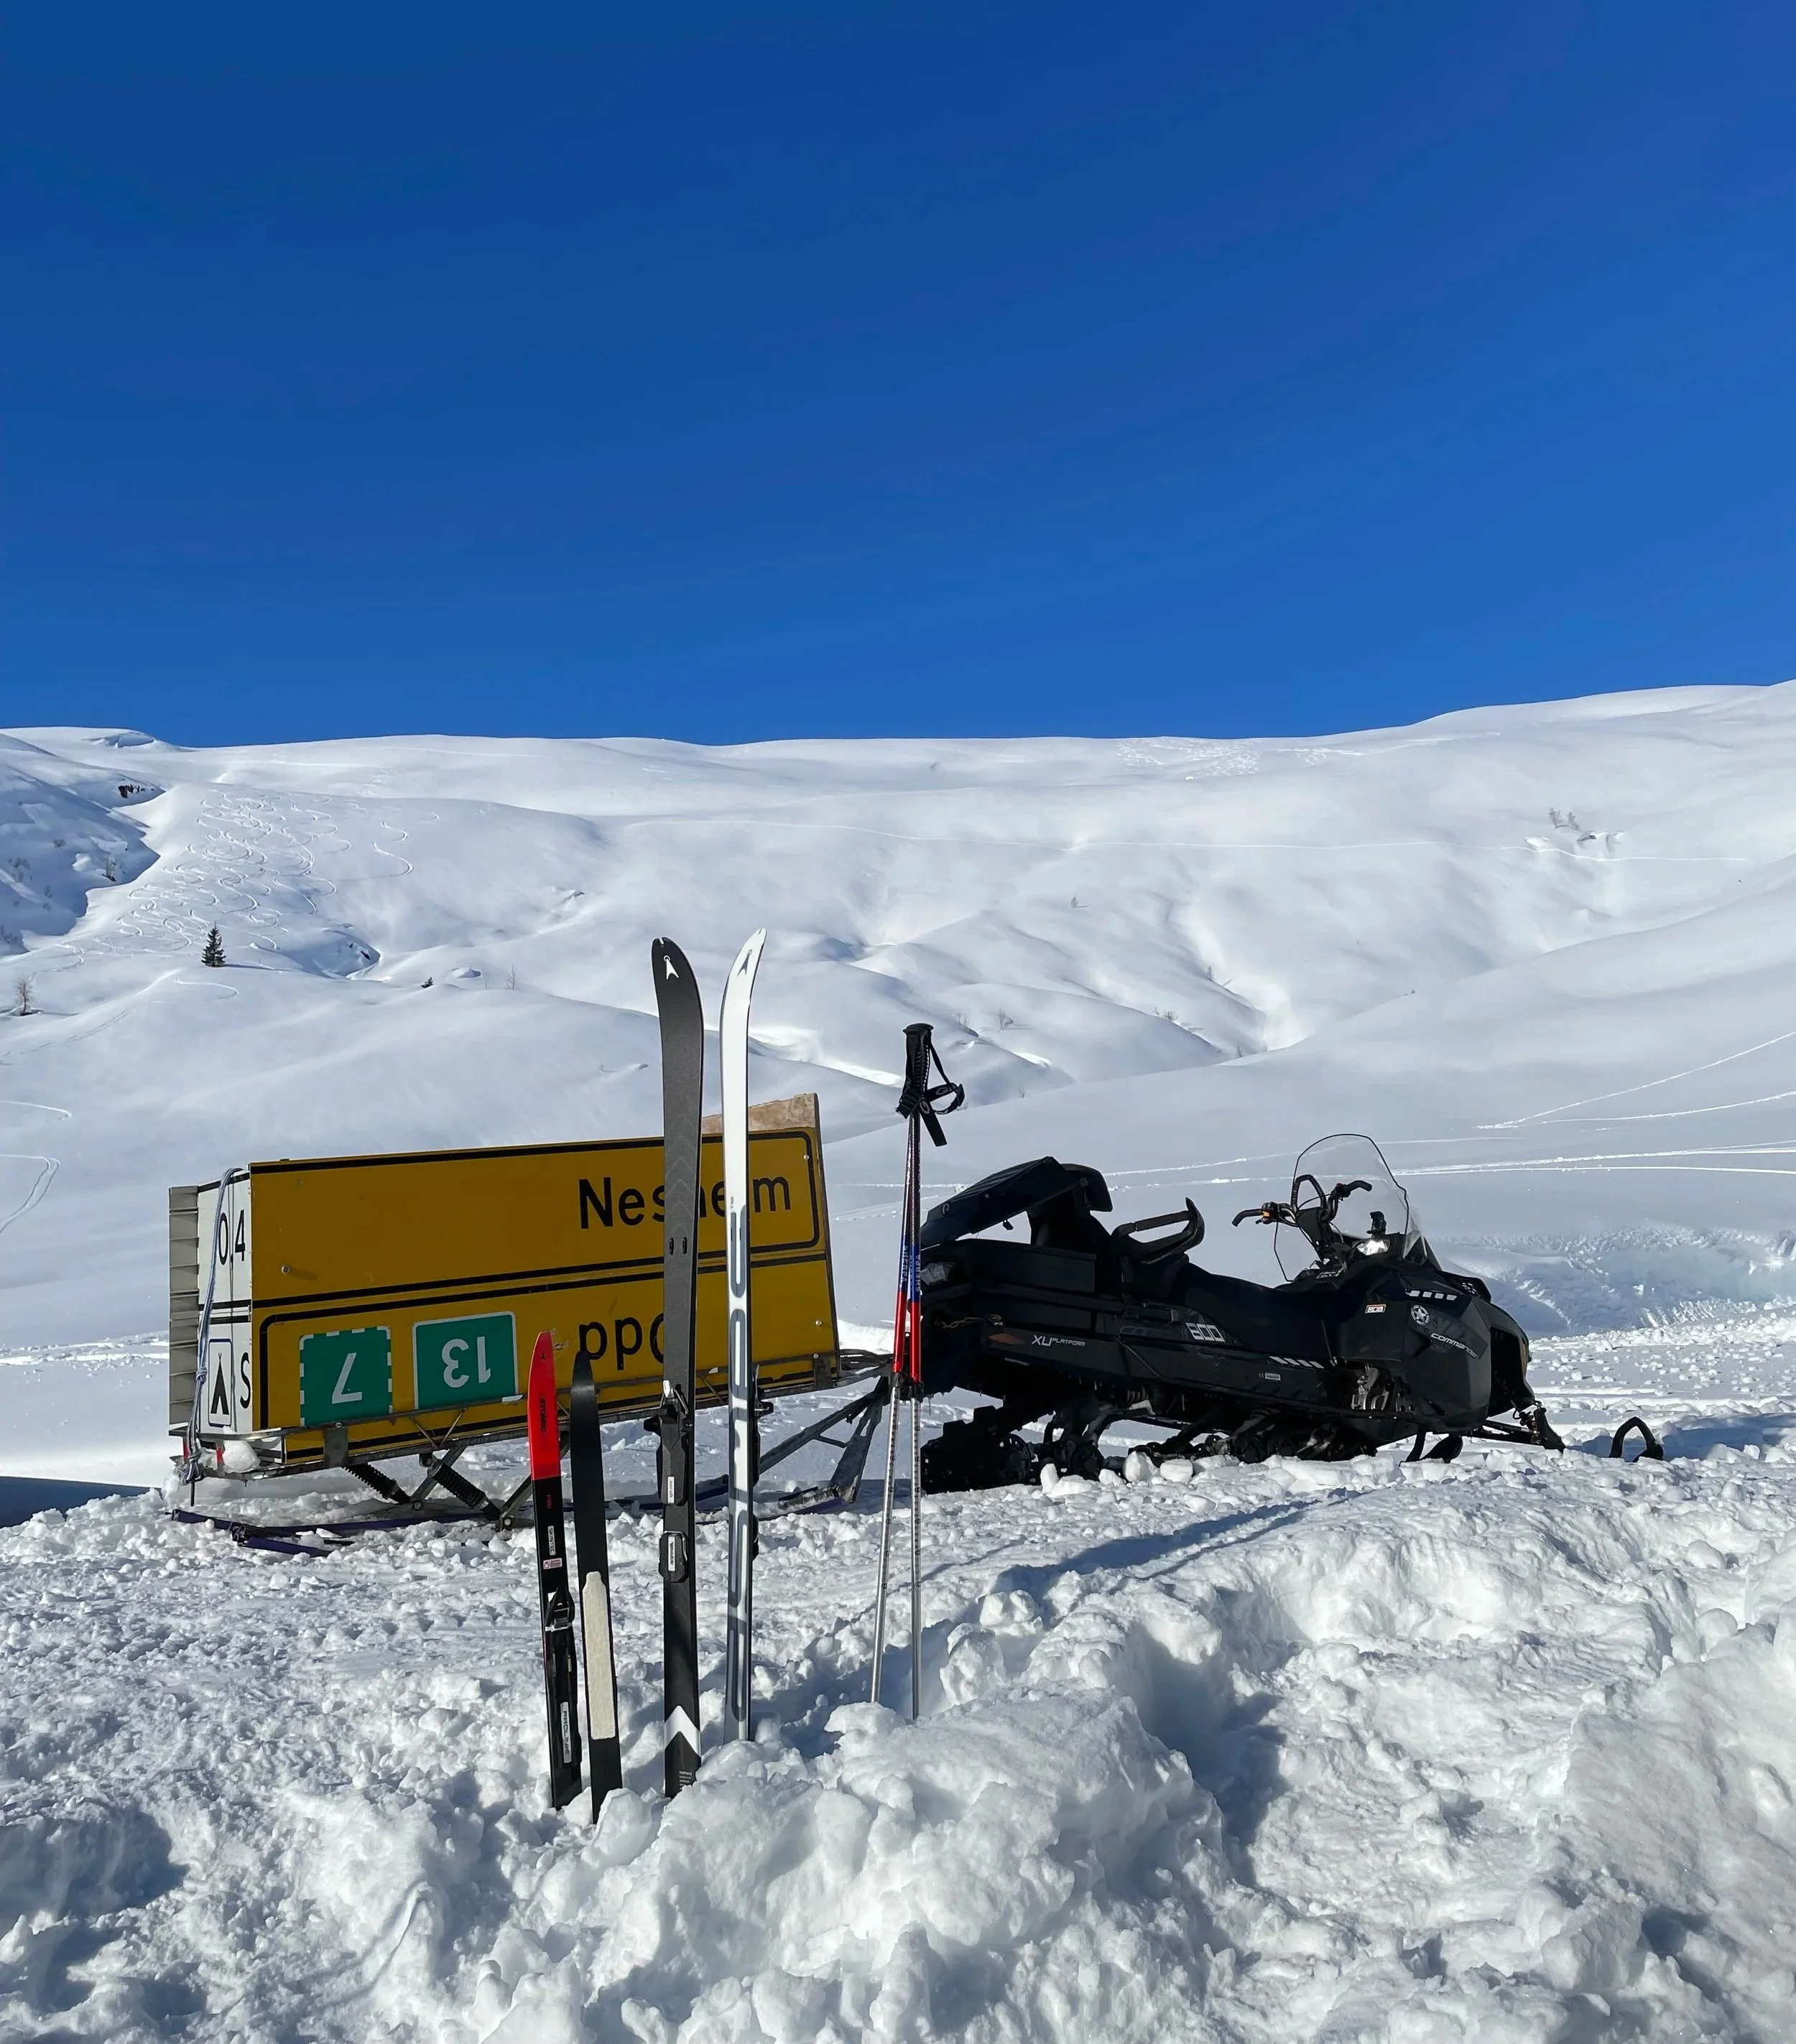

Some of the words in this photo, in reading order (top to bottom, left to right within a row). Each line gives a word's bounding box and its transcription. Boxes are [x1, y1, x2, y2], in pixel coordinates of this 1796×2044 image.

[240, 1352, 251, 1409] S
[332, 1352, 362, 1404] 7
[442, 1337, 491, 1388] 13
